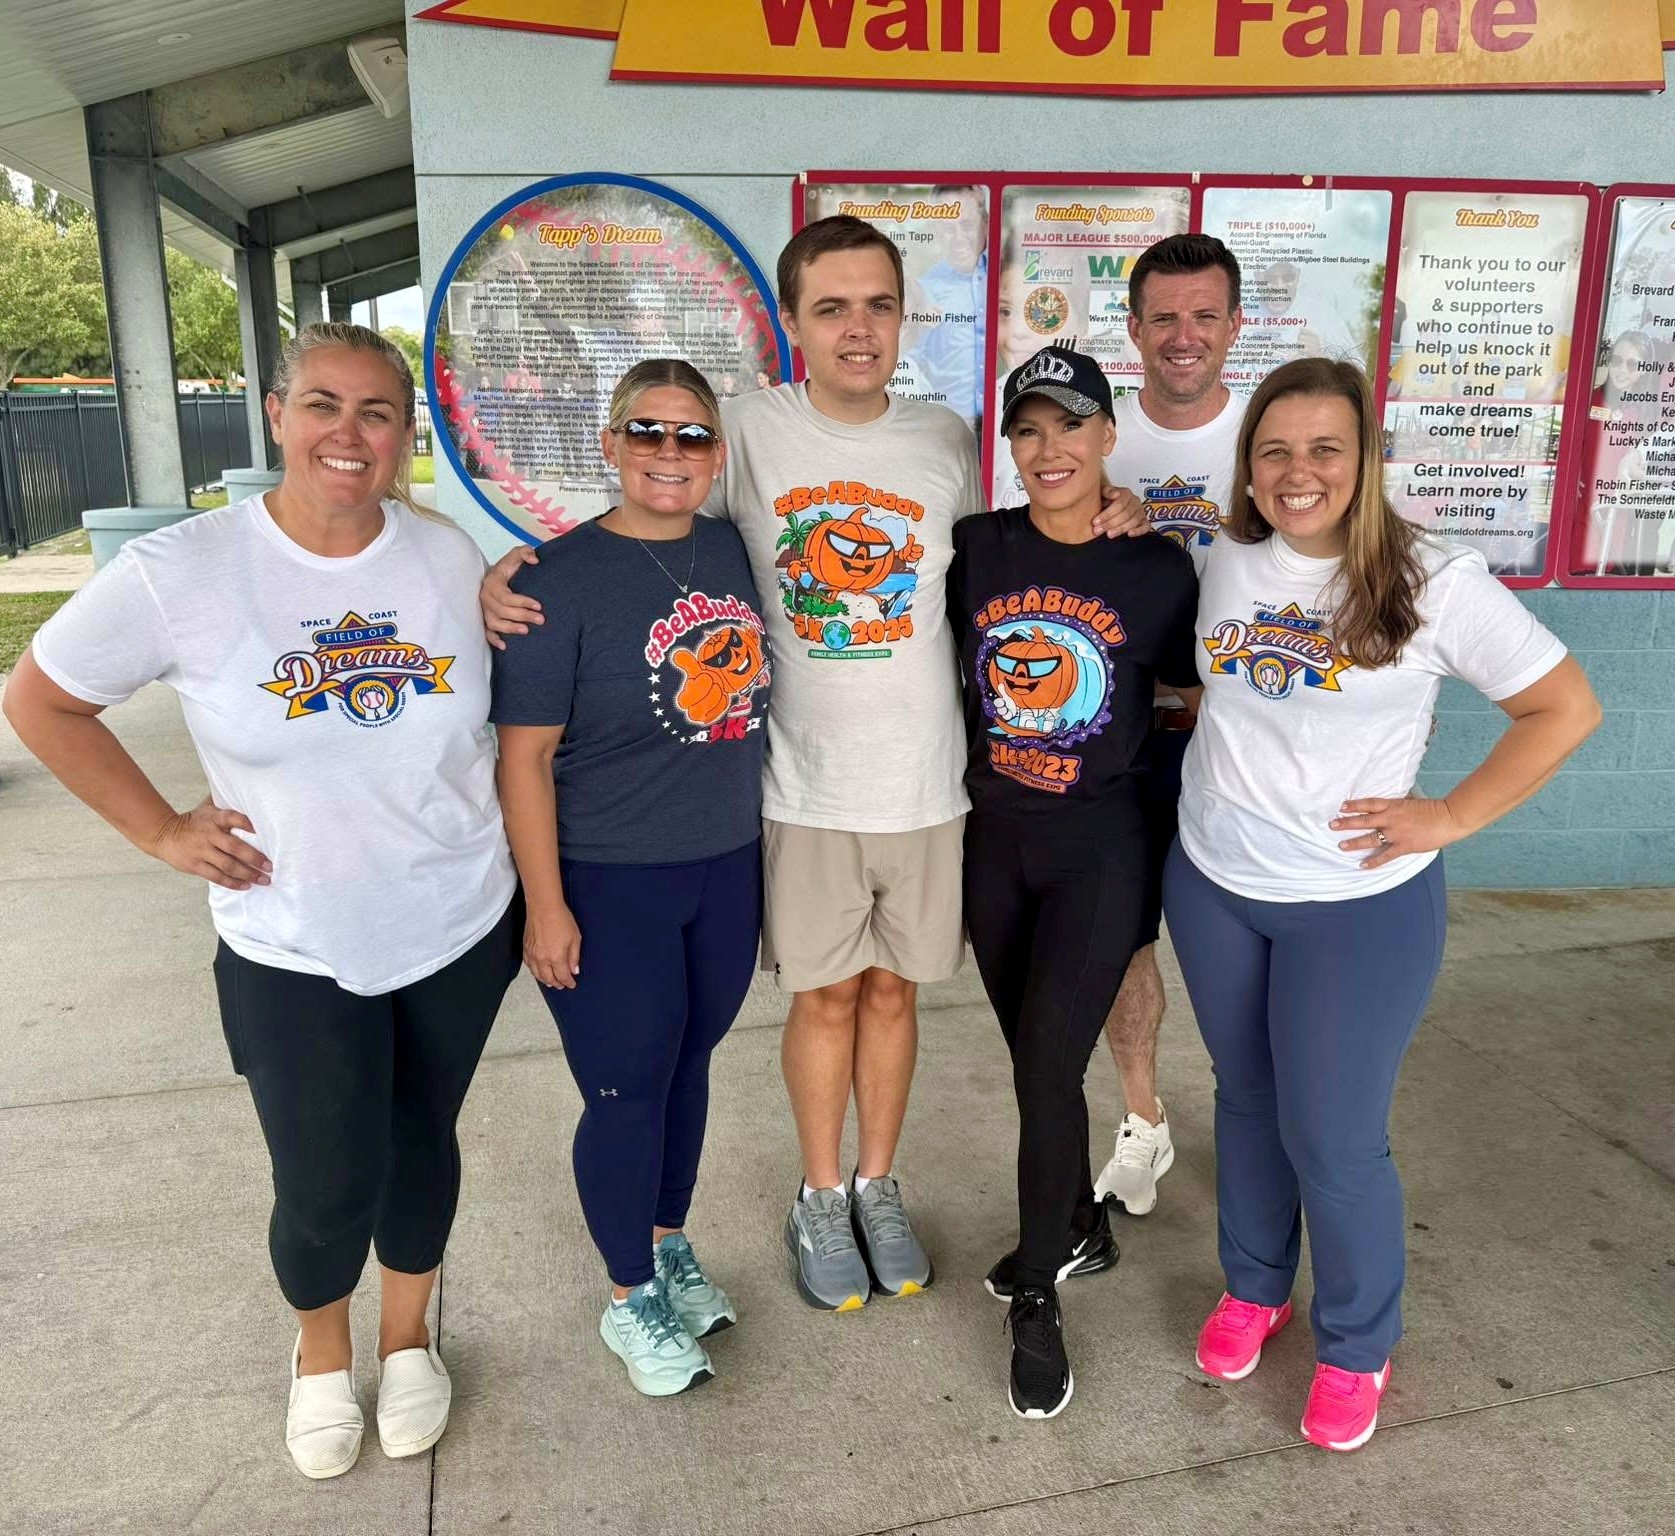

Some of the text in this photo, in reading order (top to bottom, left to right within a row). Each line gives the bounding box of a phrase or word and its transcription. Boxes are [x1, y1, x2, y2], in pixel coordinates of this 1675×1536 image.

[761, 0, 1538, 57] Wall of Fame
[838, 201, 961, 223] Founding Board
[1035, 203, 1155, 225] Founding Sponsors
[1455, 209, 1540, 228] Thank You
[1227, 221, 1316, 232] TRIPLE ($10,000+)
[539, 223, 663, 249] Tapp's Dream
[889, 231, 934, 245] Jim Tapp
[1023, 232, 1064, 242] MAJOR
[1066, 233, 1110, 243] LEAGUE
[1256, 232, 1294, 240] Engineering
[1340, 257, 1370, 265] Buildings
[1419, 255, 1566, 274] Thank you to our
[1444, 278, 1536, 293] volunteers
[1632, 284, 1674, 296] Brevard
[1432, 298, 1544, 316] & supporters
[911, 312, 942, 322] Robin
[944, 313, 978, 323] Fisher
[1089, 315, 1110, 323] West
[1263, 317, 1308, 327] ($5,000+)
[1653, 315, 1675, 327] Fran
[1416, 319, 1554, 336] who continue to
[1079, 346, 1120, 354] CORPORATION
[1415, 340, 1551, 356] help us knock it
[1418, 362, 1543, 378] out of the park
[1637, 361, 1665, 374] Holly
[1221, 372, 1252, 380] INGLE
[1462, 383, 1494, 396] and
[1620, 391, 1658, 402] Jacobs
[1419, 403, 1533, 418] make dreams
[1428, 424, 1520, 438] come true!
[1603, 420, 1658, 434] Knights of
[1609, 436, 1675, 448] Lucky's Mark
[1645, 451, 1675, 462] Micha
[1414, 463, 1525, 478] Get involved!
[1646, 465, 1675, 476] Micha
[1595, 479, 1662, 490] Robin Fisher
[1406, 484, 1528, 500] Learn more by
[1598, 494, 1617, 504] The
[773, 480, 924, 522] #BeABuddy
[1144, 503, 1220, 531] reams
[1434, 504, 1496, 520] visiting
[1634, 509, 1666, 520] Waste
[1428, 527, 1534, 538] astfieldofdreams.org
[974, 586, 1126, 645] #BeABuddy
[1252, 600, 1332, 617] SPACE COAST
[300, 610, 398, 628] SPACE COAST
[1263, 614, 1295, 626] FIELD
[325, 628, 385, 642] FIELD OF
[645, 592, 766, 668] #BeABuddy
[793, 614, 914, 646] 5K 2025
[1211, 619, 1335, 671] Dreams
[273, 648, 437, 699] Dreams
[1023, 748, 1080, 782] 2023
